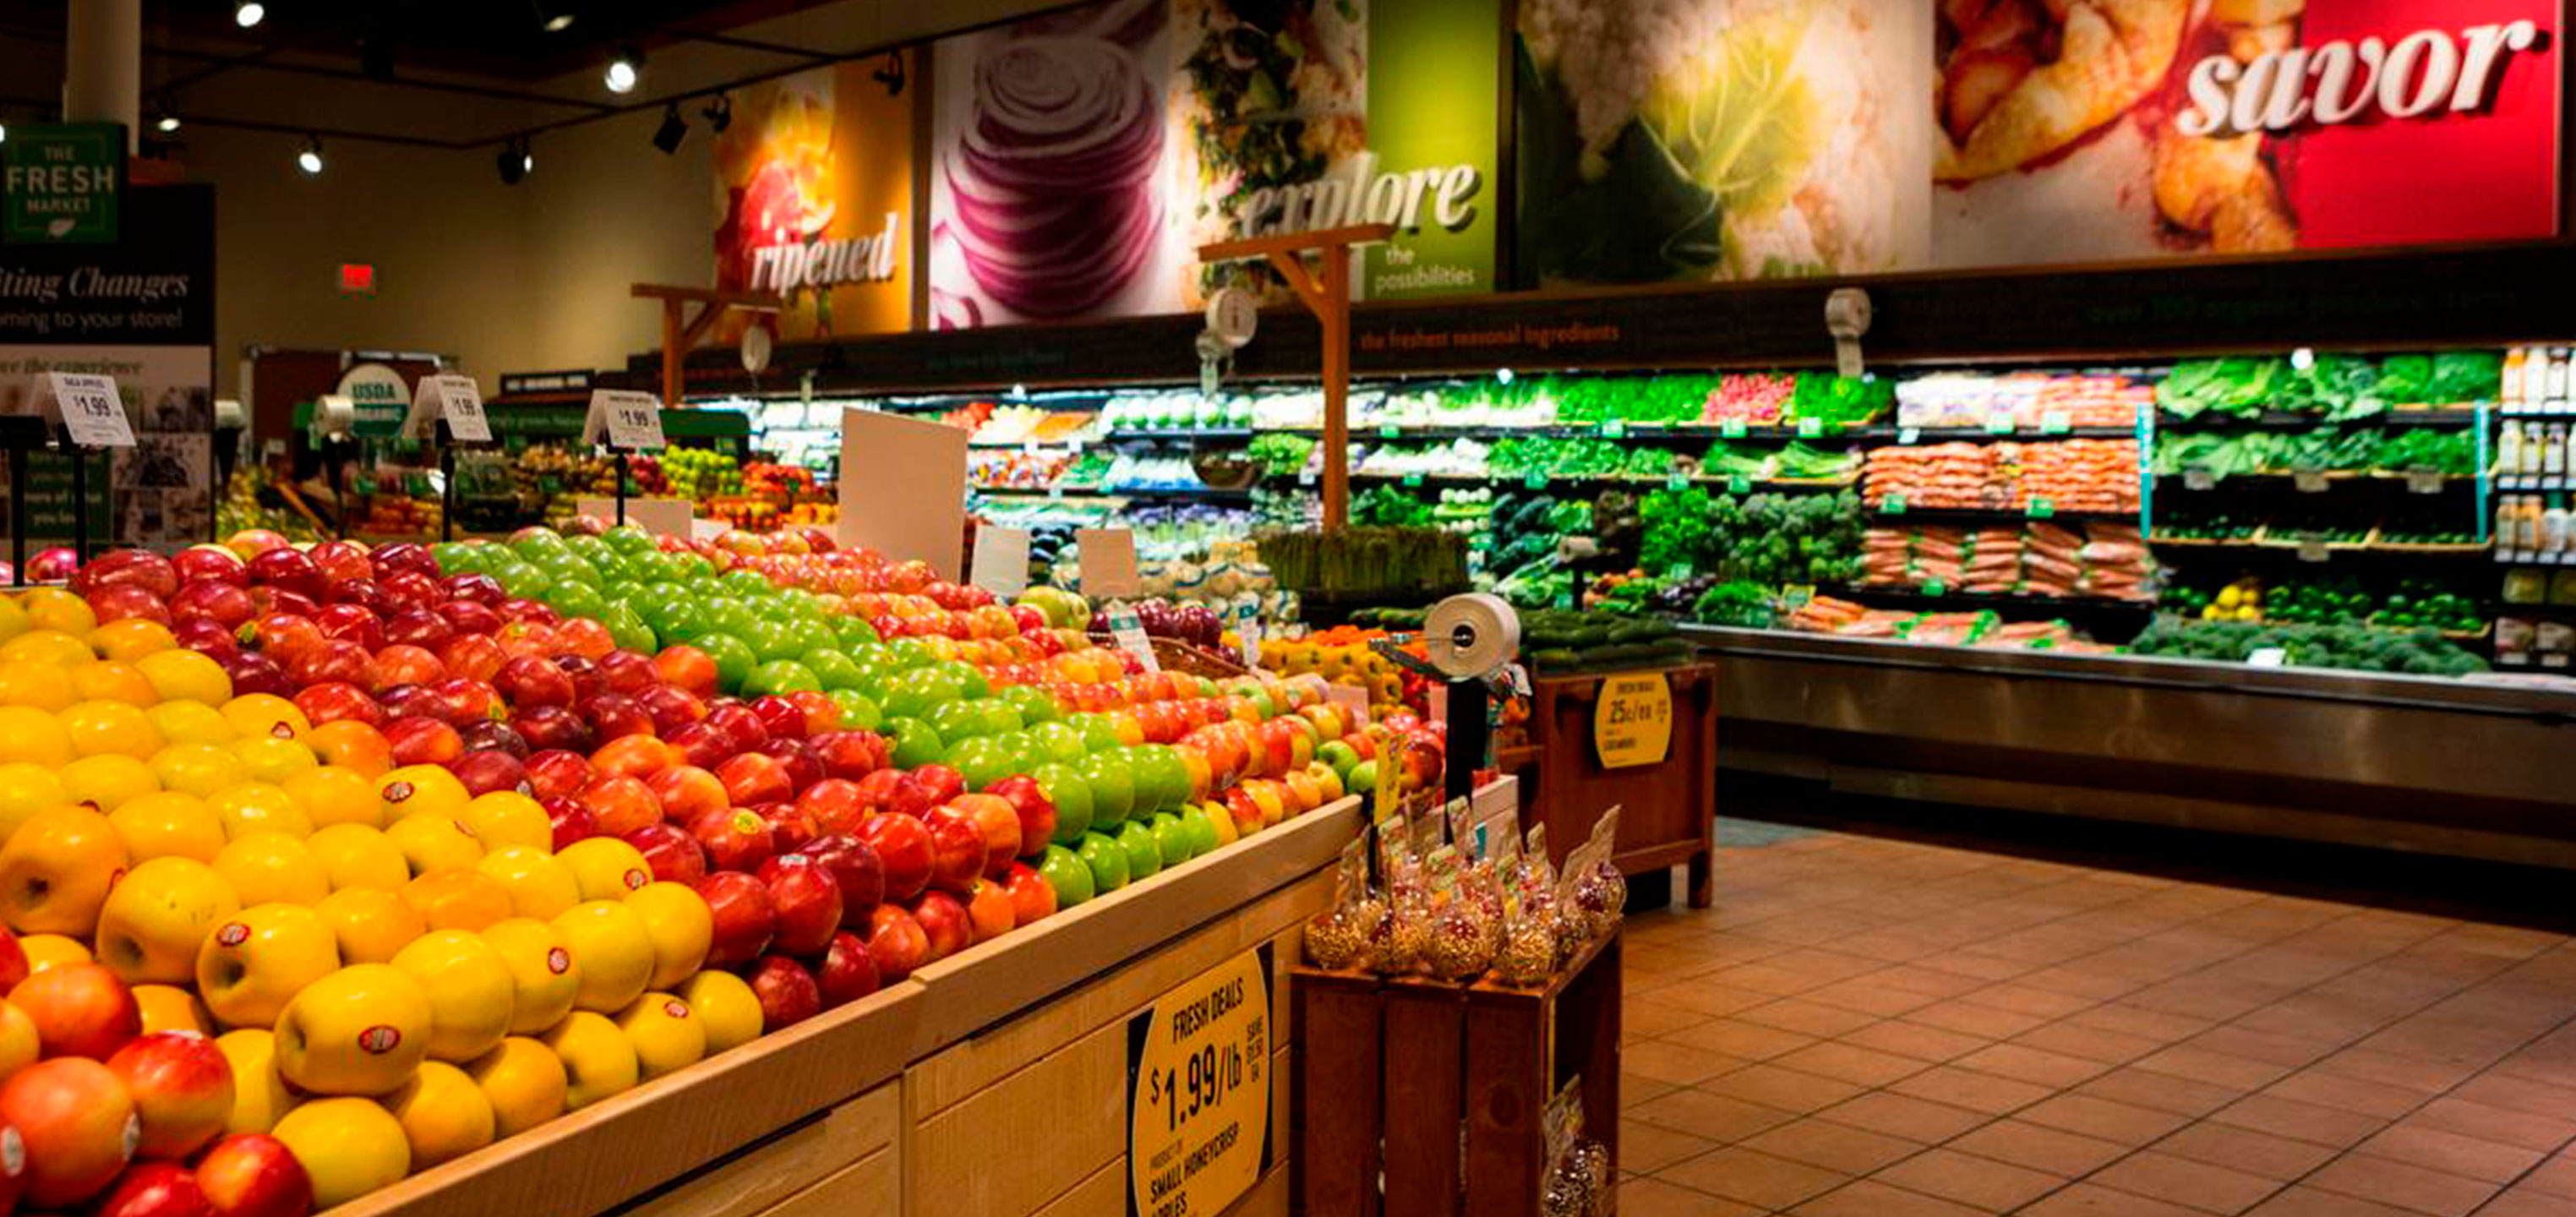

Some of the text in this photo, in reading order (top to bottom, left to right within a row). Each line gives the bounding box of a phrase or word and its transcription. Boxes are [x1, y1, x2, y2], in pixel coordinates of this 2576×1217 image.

[2175, 19, 2536, 137] savor
[44, 145, 75, 161] THE
[6, 165, 116, 194] FRESH
[1243, 150, 1477, 239] explore
[26, 198, 91, 214] MARKET
[750, 212, 899, 299] ripened
[1384, 243, 1415, 265] the
[68, 265, 190, 304] Changes
[1374, 264, 1475, 294] possibilities
[53, 309, 76, 328] to
[79, 311, 125, 335] your
[129, 305, 183, 329] store!
[1360, 320, 1619, 351] the freshest seasonal ingredients
[73, 395, 111, 417] $1.99
[352, 383, 396, 399] USDA
[1172, 977, 1245, 1045] FRESH DEALS
[1150, 1121, 1239, 1204] SMALL HONEYCRISP
